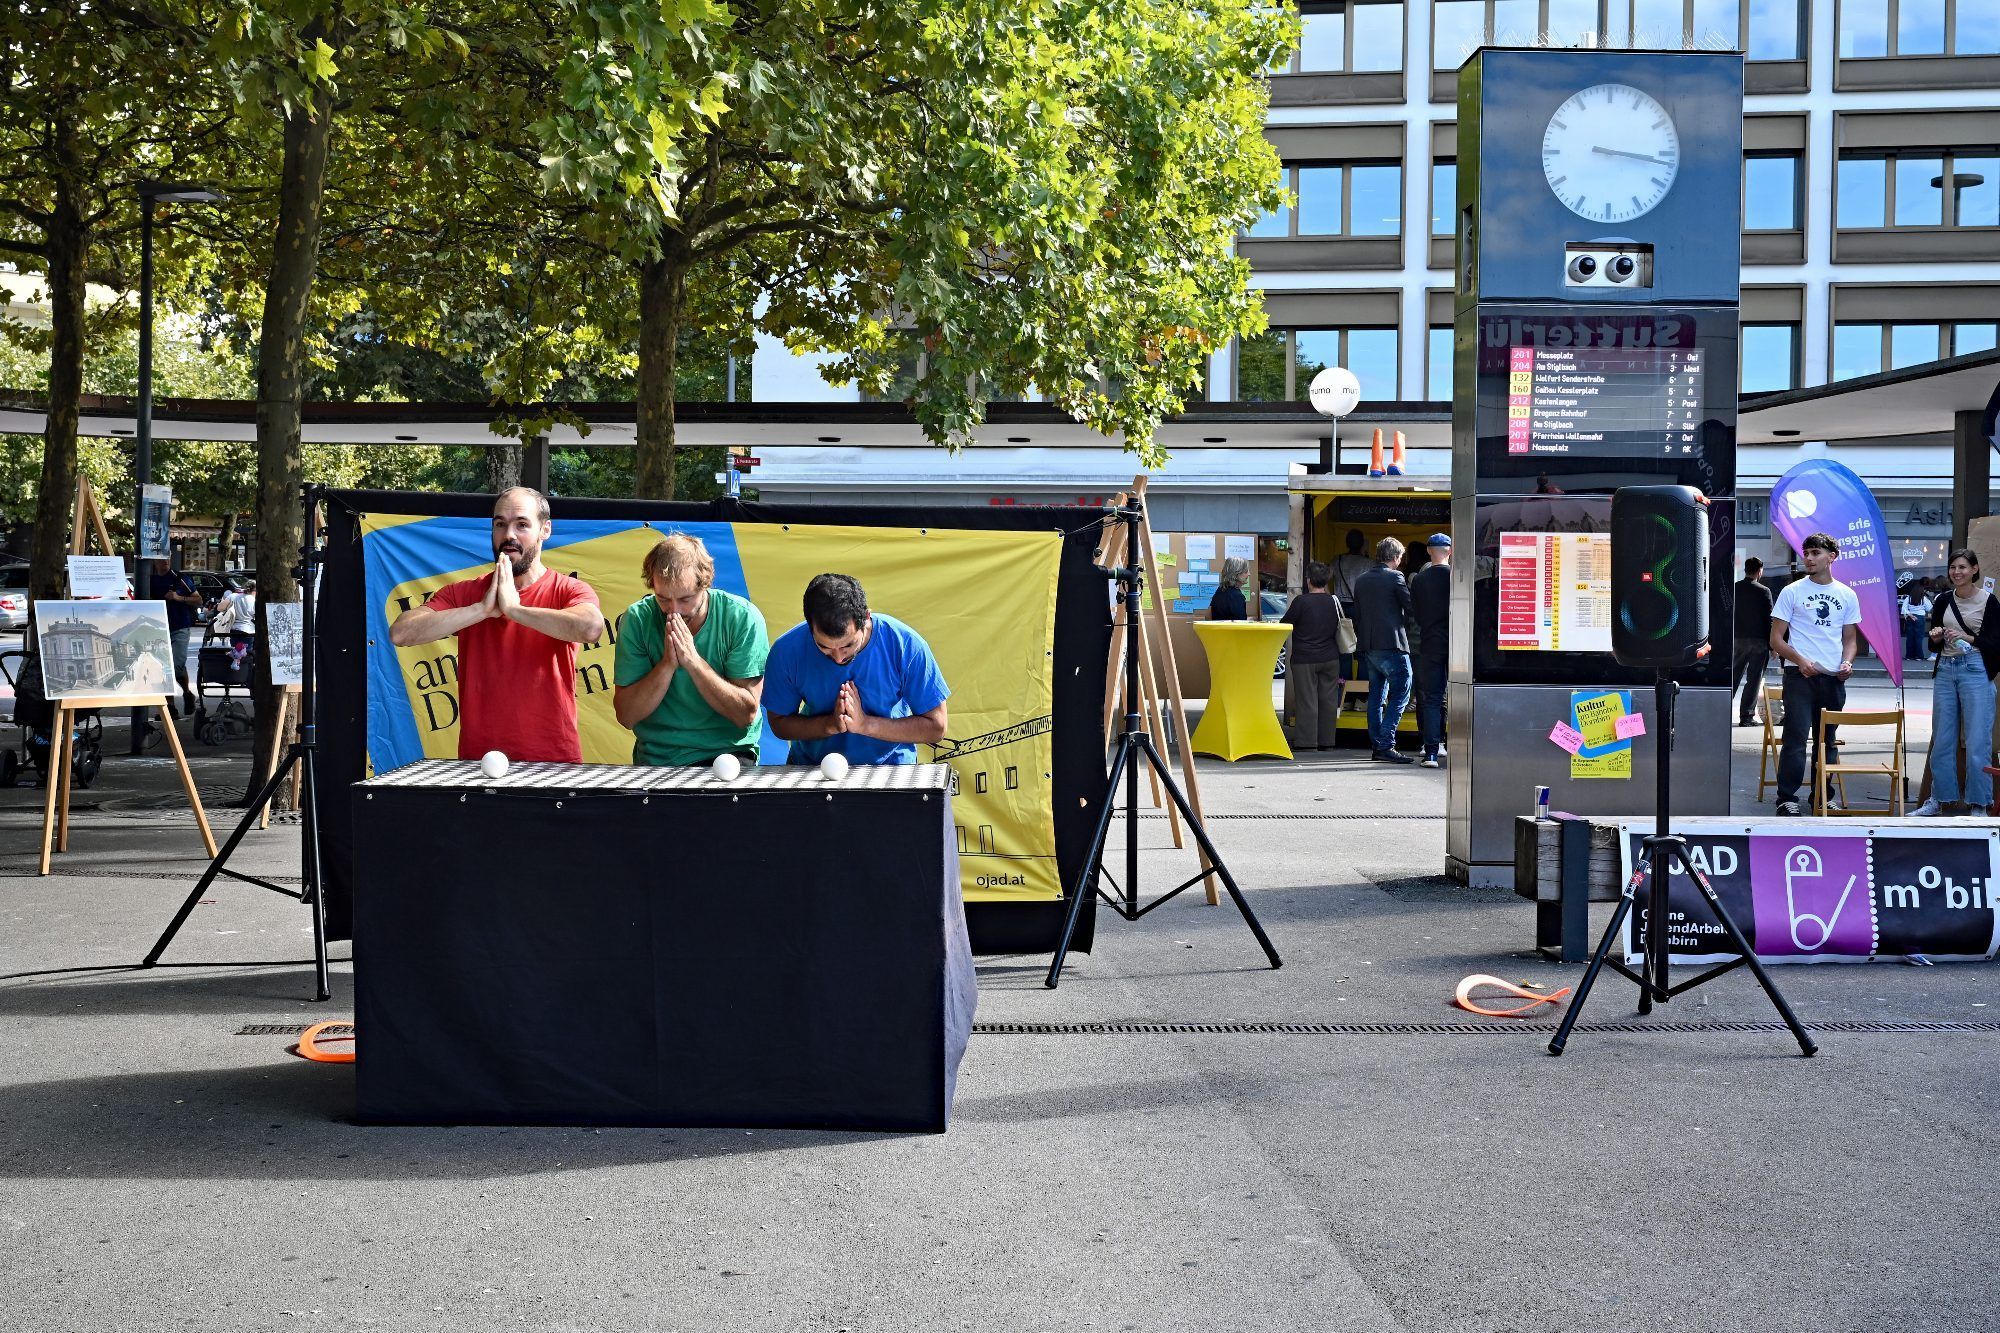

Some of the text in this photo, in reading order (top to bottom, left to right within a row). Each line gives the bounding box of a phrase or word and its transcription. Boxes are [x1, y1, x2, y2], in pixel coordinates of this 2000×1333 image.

[1513, 351, 1530, 359] 201
[1536, 352, 1573, 360] Messeplatz
[1513, 362, 1530, 370] 204
[1547, 363, 1576, 372] Stiglbach
[1684, 365, 1700, 373] West
[1513, 373, 1529, 382] 132
[1535, 375, 1560, 383] Wolfurt
[1513, 385, 1529, 393] 160
[1557, 386, 1599, 395] Kesslerplatz
[1511, 397, 1528, 405] 212
[1534, 397, 1578, 407] Kastenlangen
[1533, 409, 1560, 418] Bregenz
[1561, 409, 1587, 418] Bahnhof
[1510, 420, 1527, 428] 208
[1544, 421, 1573, 429] Stiglbach
[1510, 431, 1526, 439] 203
[1509, 442, 1526, 450] 210
[1532, 443, 1569, 452] Messeplatz
[1807, 593, 1843, 611] BATHING
[1814, 619, 1832, 627] APE
[1576, 699, 1606, 714] Kultur
[976, 872, 1026, 889] ojad.at
[1883, 866, 1994, 909] mobil
